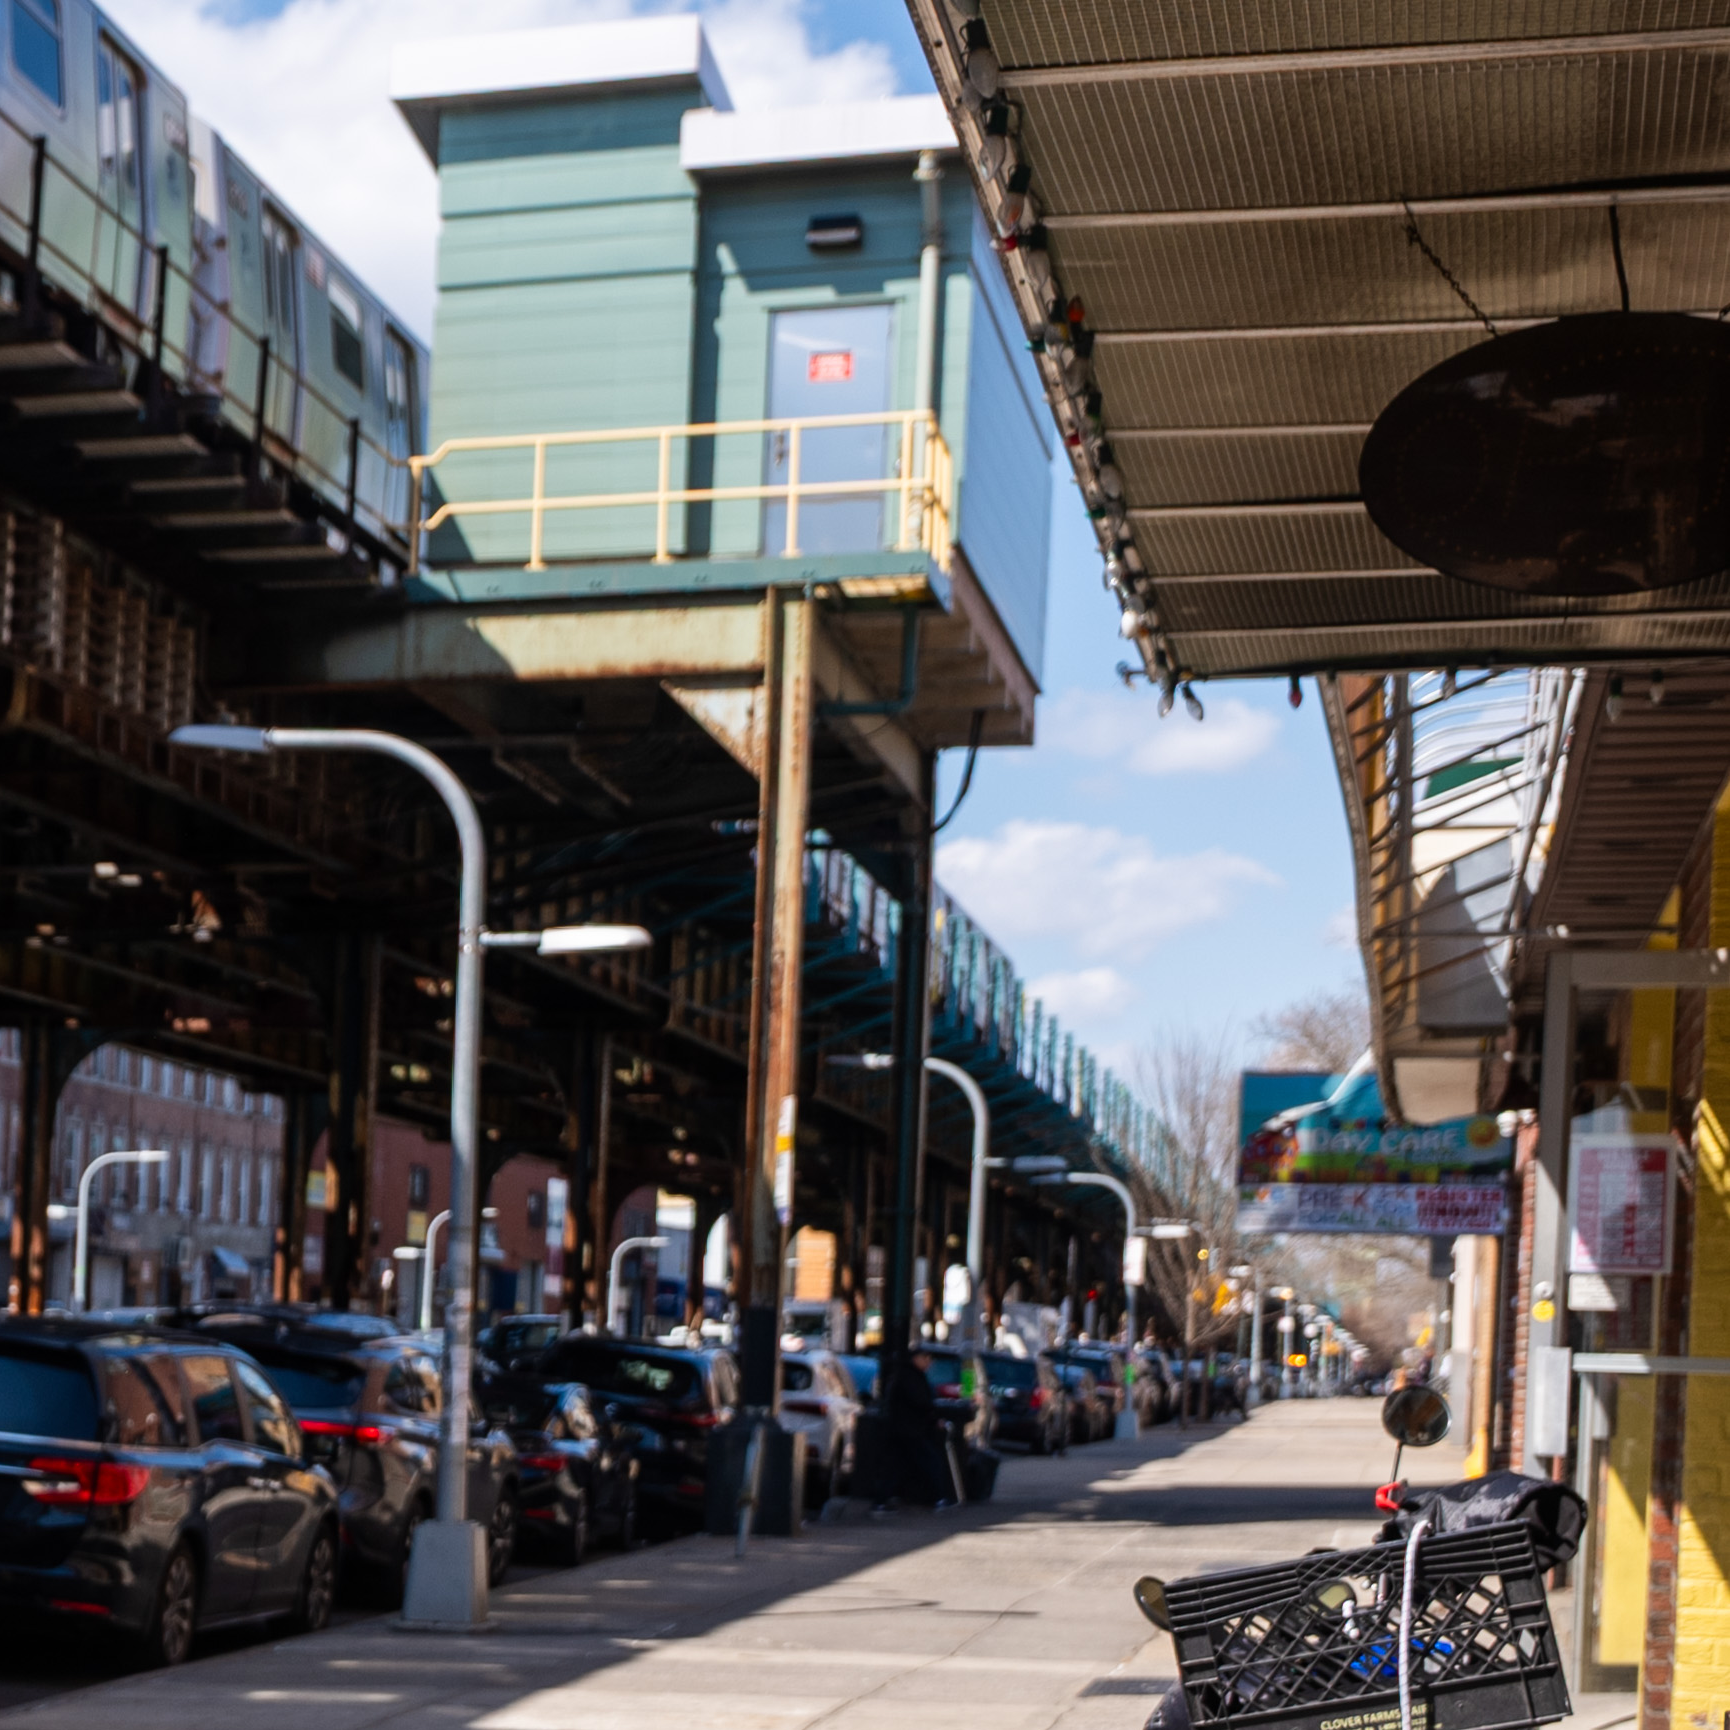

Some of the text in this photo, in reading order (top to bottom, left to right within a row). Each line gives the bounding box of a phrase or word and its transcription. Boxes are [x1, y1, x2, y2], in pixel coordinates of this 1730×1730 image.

[1313, 1126, 1463, 1153] DAY CARE
[1362, 1707, 1402, 1725] FARMS
